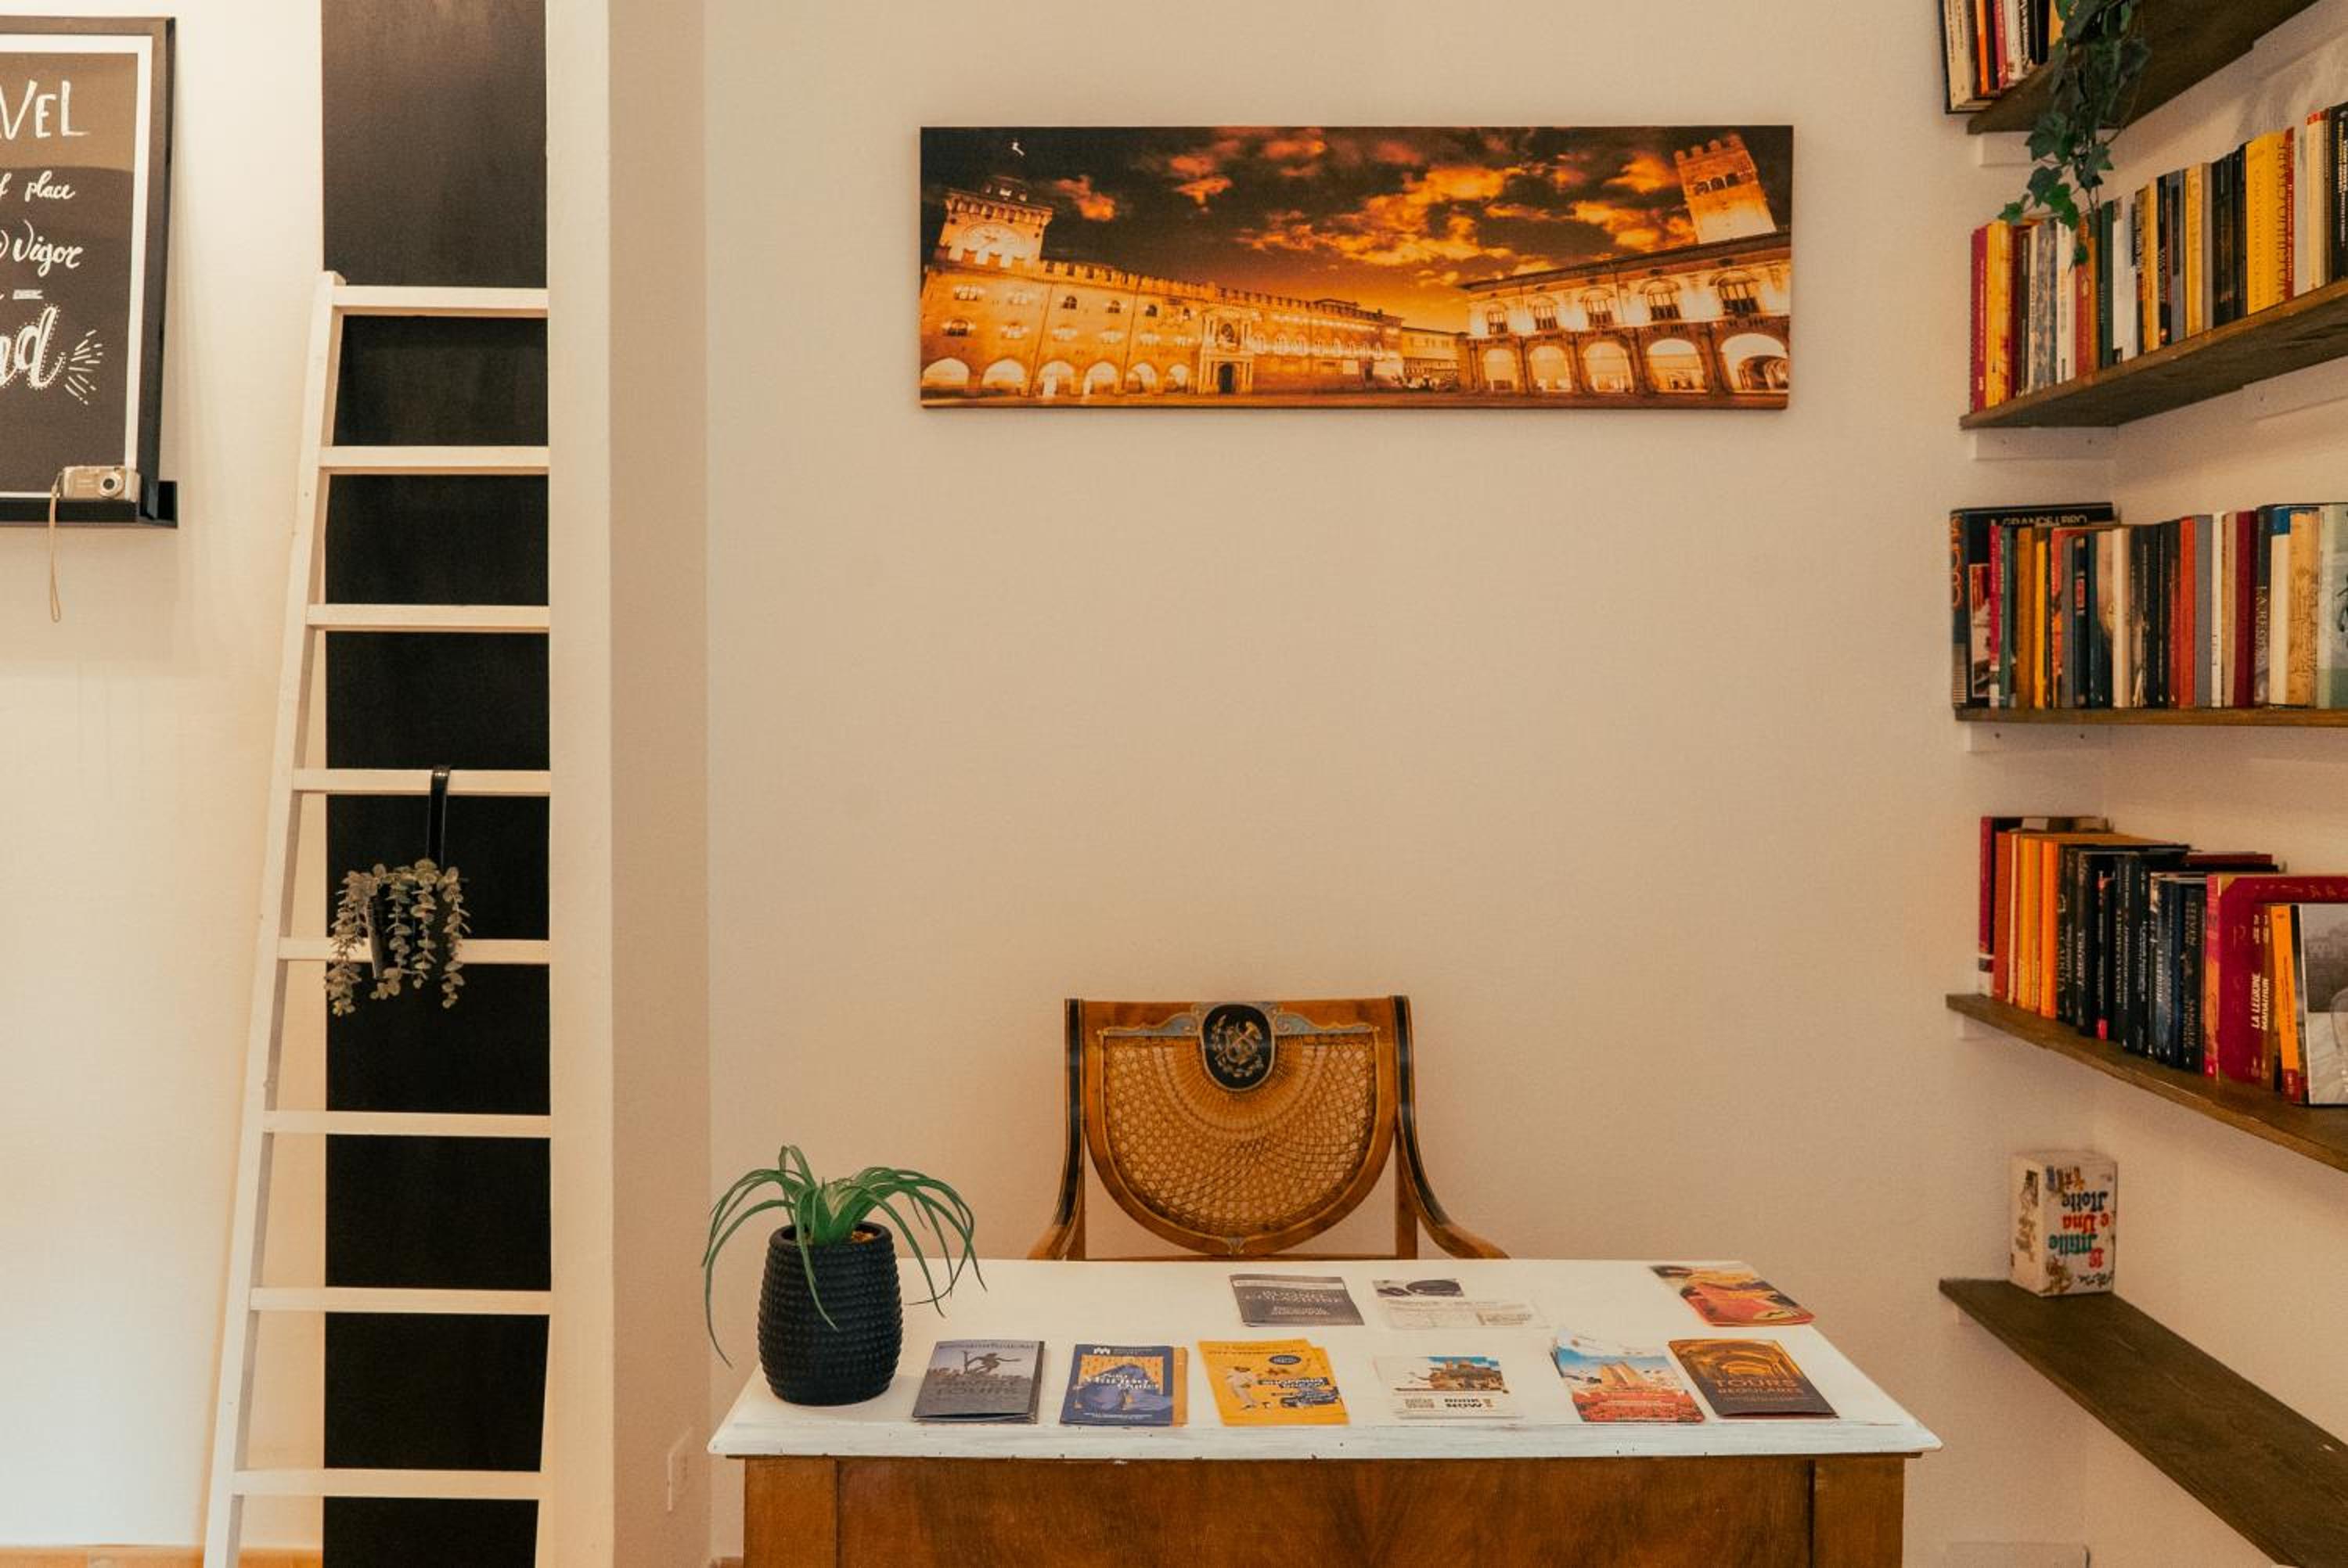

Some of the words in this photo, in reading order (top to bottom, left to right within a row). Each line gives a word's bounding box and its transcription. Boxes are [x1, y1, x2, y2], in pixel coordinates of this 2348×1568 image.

[0, 79, 92, 140] VEL
[24, 170, 76, 203] place
[13, 219, 83, 277] Vigor
